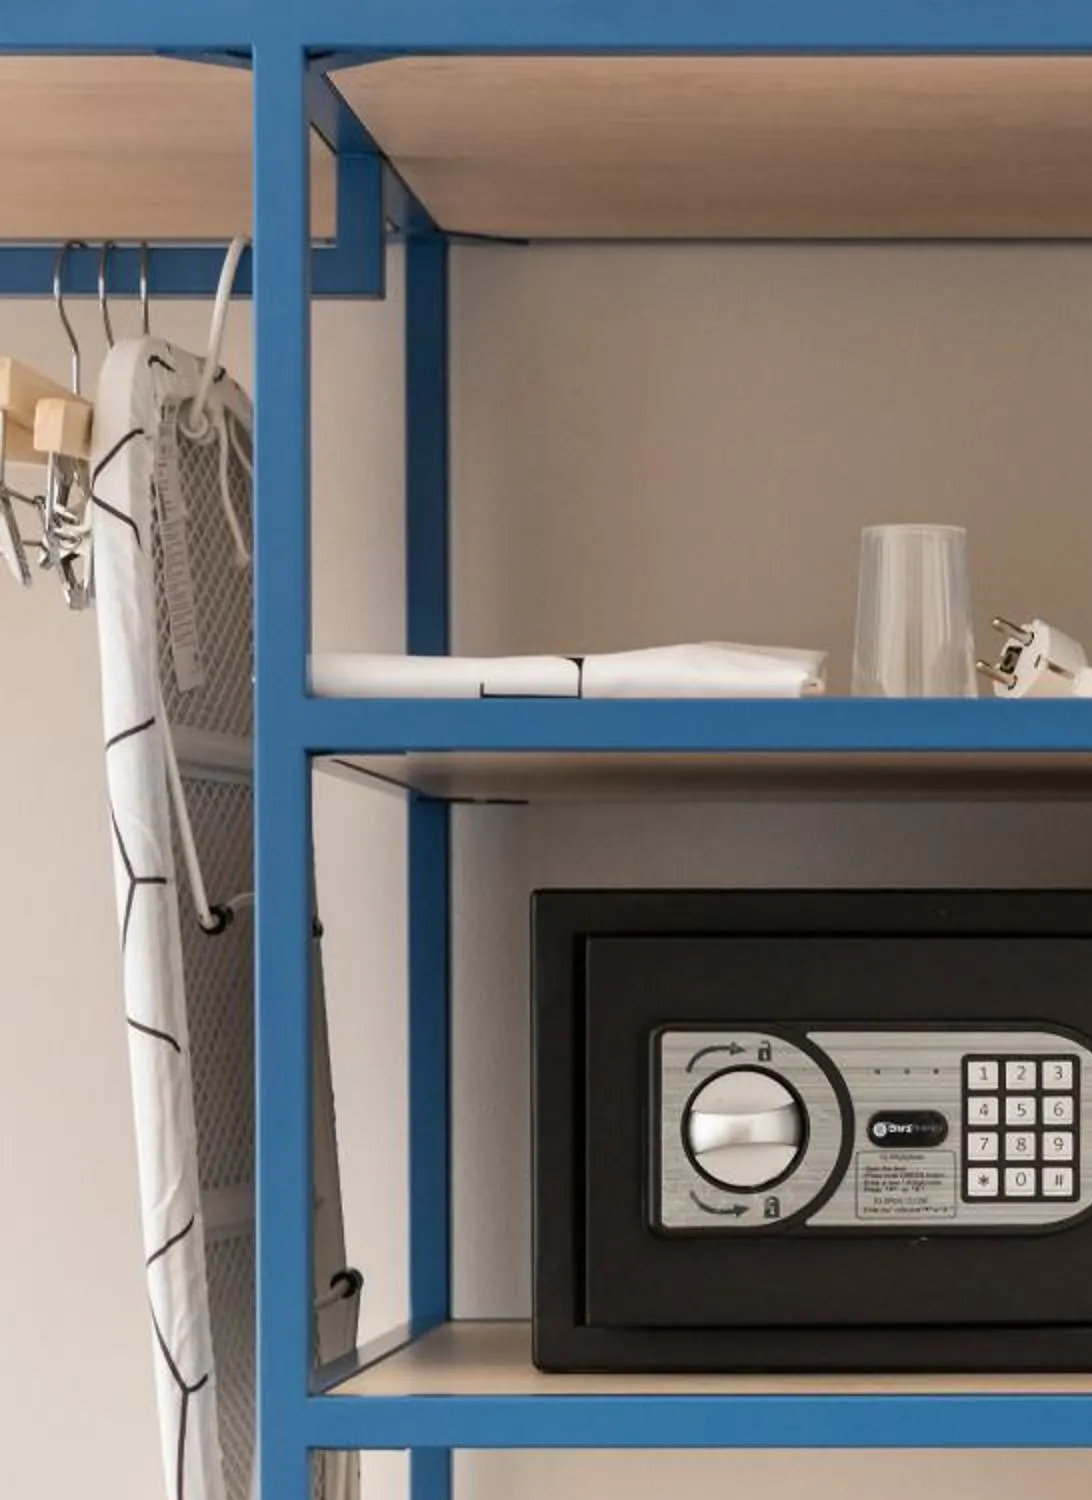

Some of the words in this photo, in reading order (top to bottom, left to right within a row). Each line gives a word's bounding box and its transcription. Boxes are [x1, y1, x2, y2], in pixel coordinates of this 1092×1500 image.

[979, 1065, 989, 1081] 1
[1016, 1065, 1027, 1081] 2
[1054, 1065, 1064, 1081] 3
[979, 1103, 989, 1117] 4
[1017, 1103, 1027, 1118] 5
[1053, 1101, 1065, 1117] 6
[979, 1137, 989, 1151] 7
[1016, 1137, 1027, 1152] 8
[1053, 1136, 1065, 1151] 9
